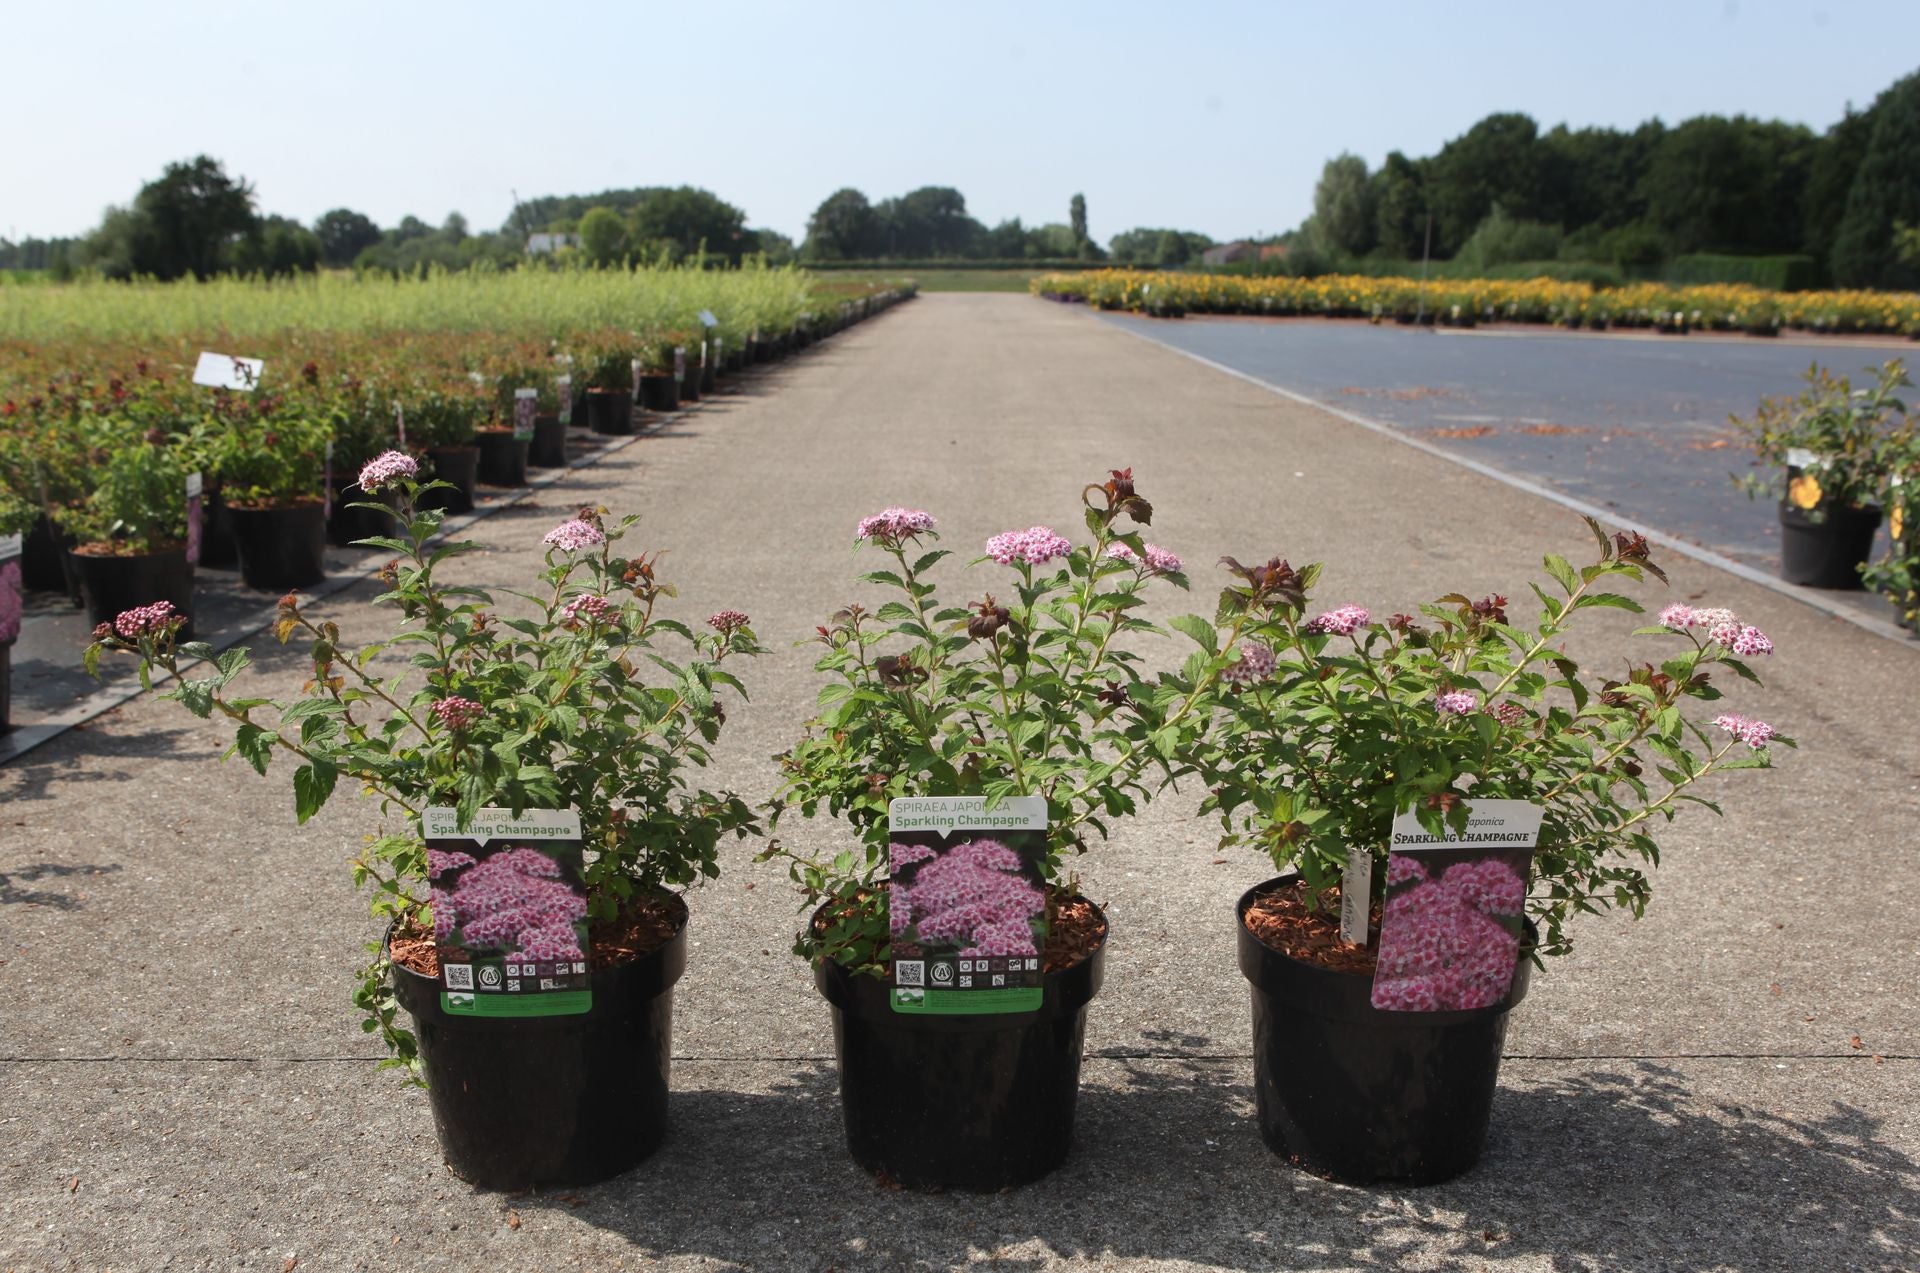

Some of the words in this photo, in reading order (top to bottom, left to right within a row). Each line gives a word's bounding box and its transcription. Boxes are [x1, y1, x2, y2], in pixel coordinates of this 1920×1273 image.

[895, 802, 948, 813] SPIRAEA
[951, 801, 1011, 812] JAPOCA
[430, 813, 480, 822] SPIR
[481, 813, 535, 823] JAPOCA
[895, 815, 955, 828] Sparkling
[958, 814, 1029, 828] Champagne
[1467, 817, 1505, 828] aponica
[431, 824, 493, 836] Sparling
[496, 824, 570, 837] Champagne
